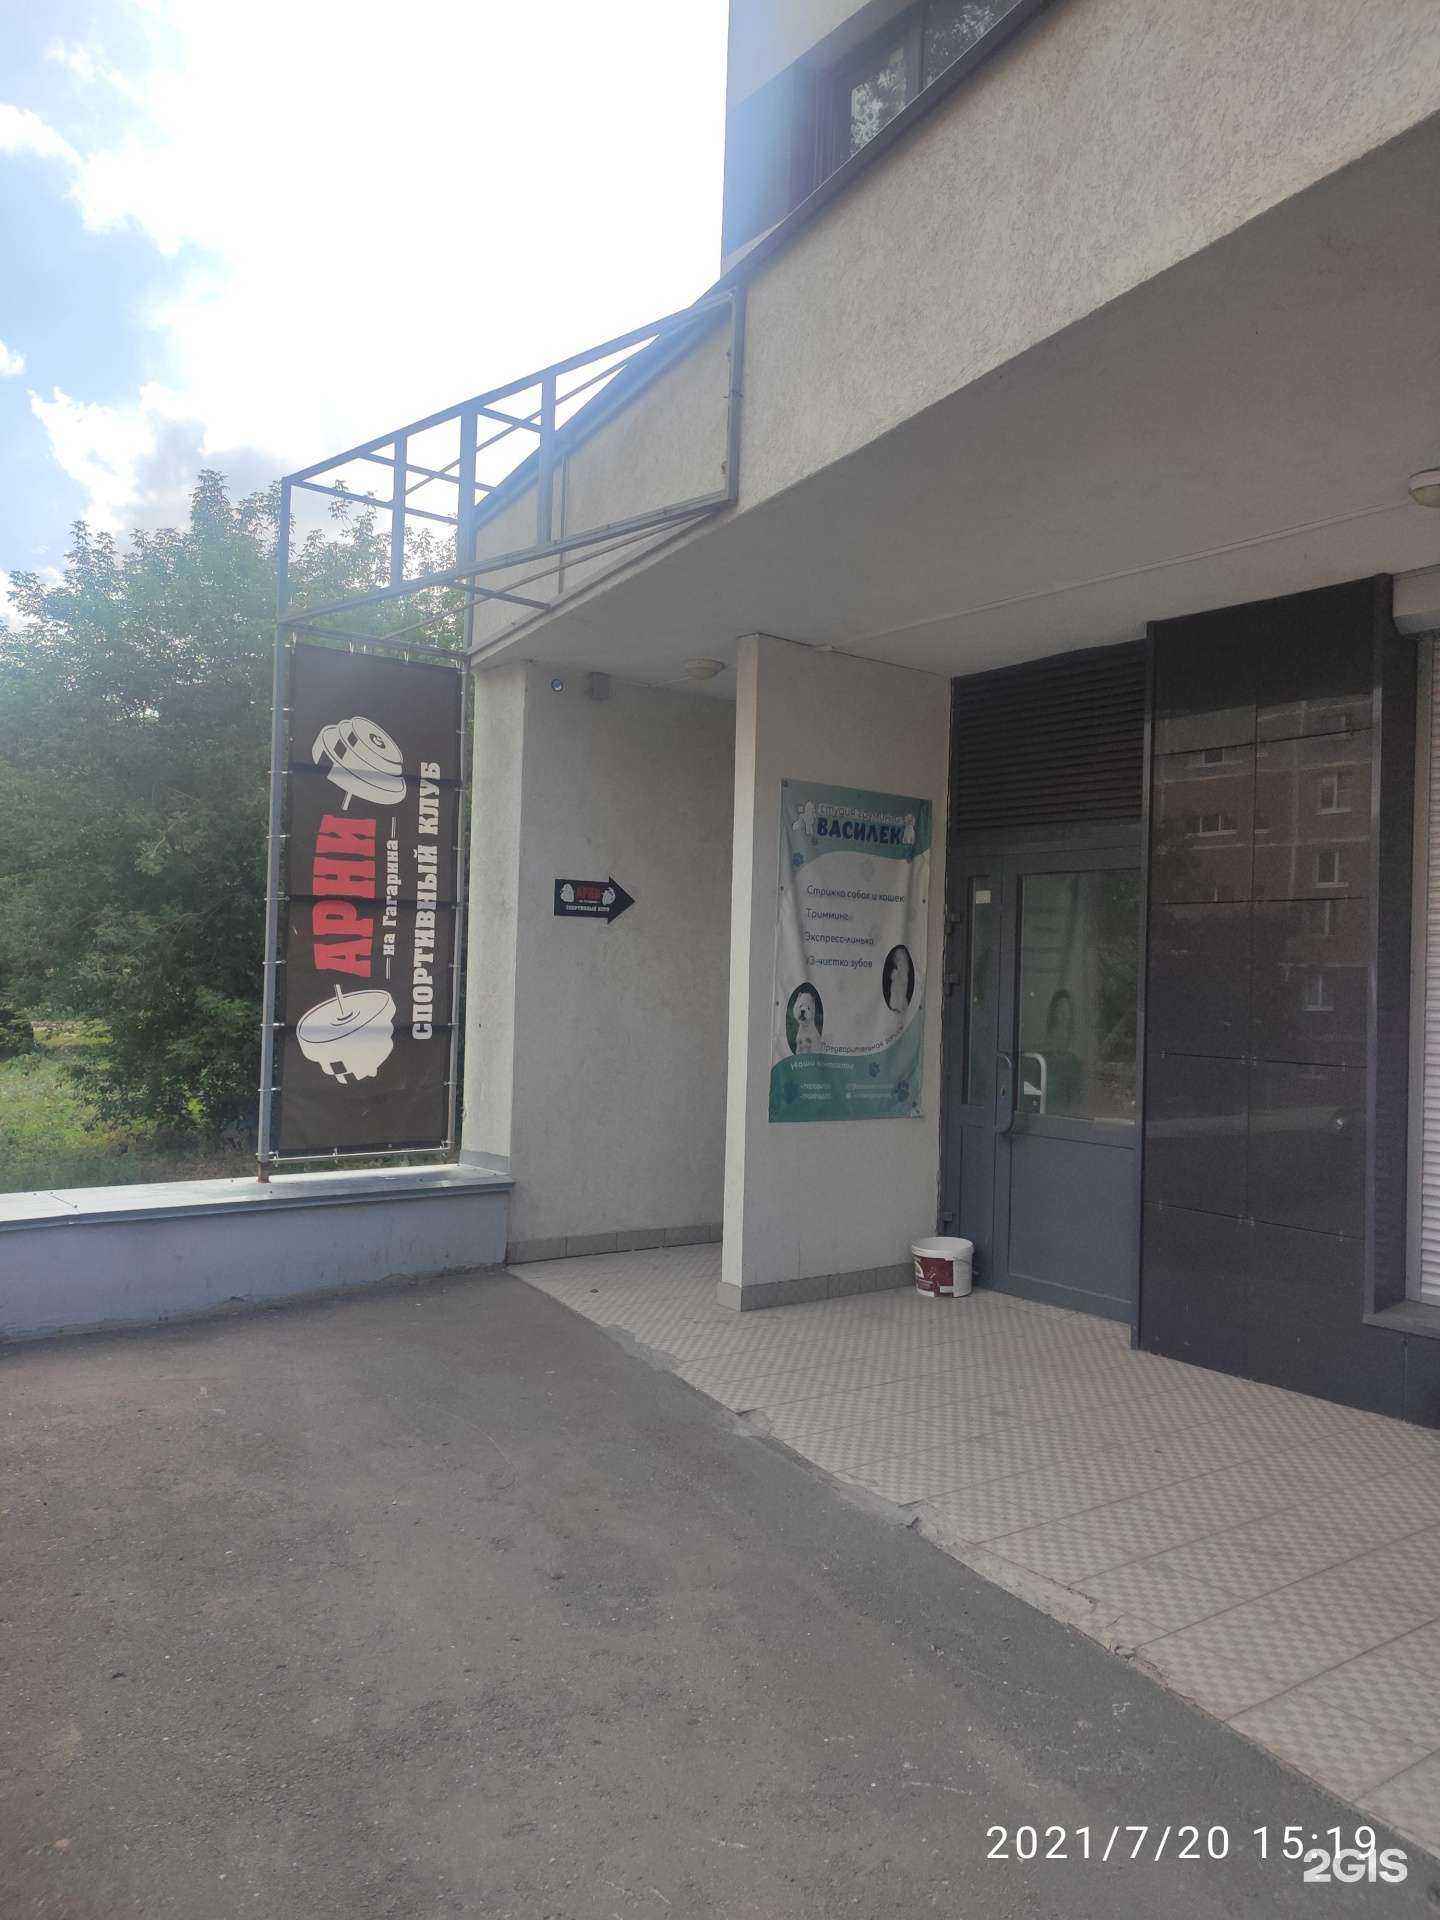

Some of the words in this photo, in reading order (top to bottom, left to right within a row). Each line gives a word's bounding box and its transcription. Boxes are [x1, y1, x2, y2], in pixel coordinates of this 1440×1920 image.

[418, 761, 441, 835] КЛУБ
[817, 817, 903, 845] ВАСИЛЕК
[312, 814, 377, 978] АРНИ
[382, 839, 402, 927] Гагарина
[806, 884, 846, 899] Стрижка
[878, 894, 905, 904] кошек
[383, 932, 396, 957] на
[411, 844, 438, 1040] СПОРТИВНЫЙ
